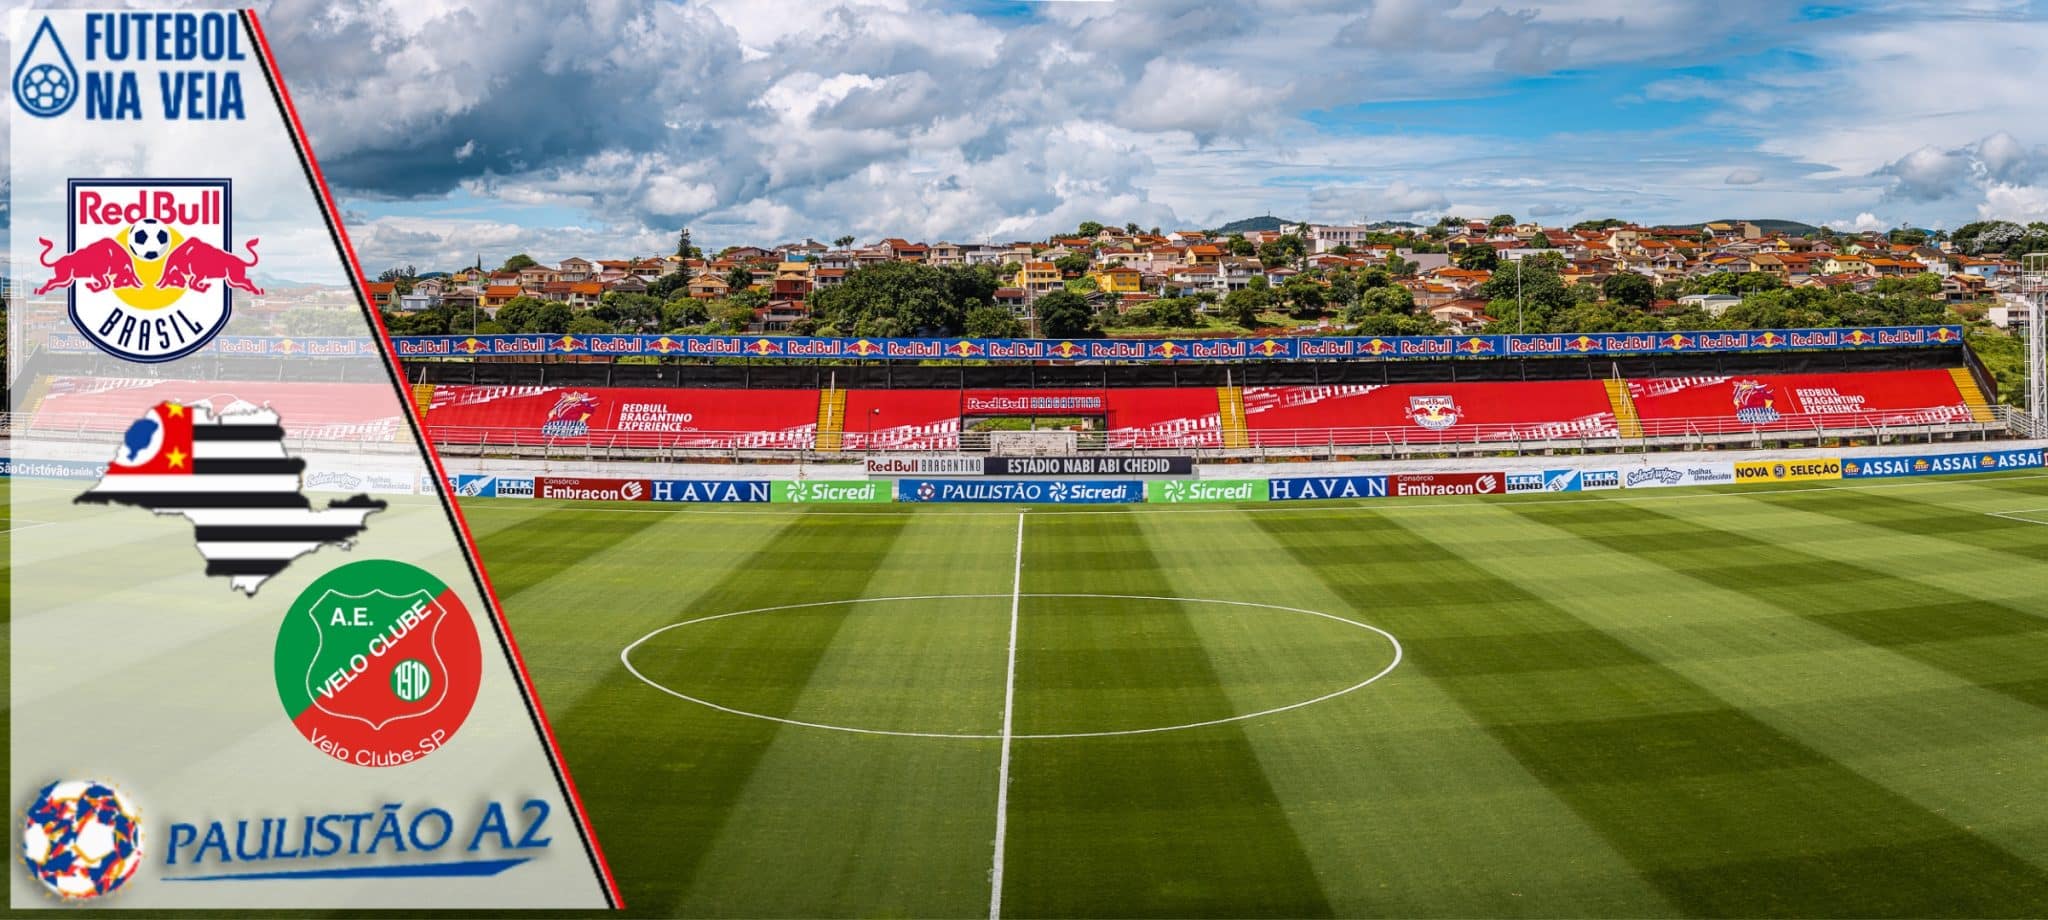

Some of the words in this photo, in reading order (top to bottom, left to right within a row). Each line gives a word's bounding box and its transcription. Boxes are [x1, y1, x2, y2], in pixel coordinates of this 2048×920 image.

[1796, 388, 1840, 397] REDBULL
[1800, 395, 1865, 405] BRAGANTINO
[622, 403, 668, 413] REDBULL
[619, 413, 693, 422] BRAGANTINO
[19, 463, 70, 477] Cristóvão
[921, 460, 982, 473] BRAGANTINO
[1008, 456, 1059, 473] ESTÁDIO
[1064, 458, 1095, 473] NABI
[1098, 458, 1121, 473] ABI
[1124, 458, 1170, 473] CHEDID
[1736, 467, 1769, 478] NOVA
[1790, 463, 1839, 479] SELEÇÃO
[1507, 474, 1543, 483] TEK
[1584, 471, 1618, 480] TEK
[498, 479, 533, 488] TEK
[1271, 477, 1388, 499] HAVAN
[1398, 482, 1473, 496] Embracon
[1507, 482, 1543, 491] BOND
[1584, 479, 1618, 488] BOND
[498, 487, 533, 496] BOND
[544, 486, 619, 500] Embracon
[653, 481, 769, 502] HAVAN
[811, 484, 875, 500] Sicredi
[942, 483, 1041, 499] PAULISTÃO
[1071, 485, 1126, 499] Sicredi
[1188, 483, 1252, 499] Sicredi
